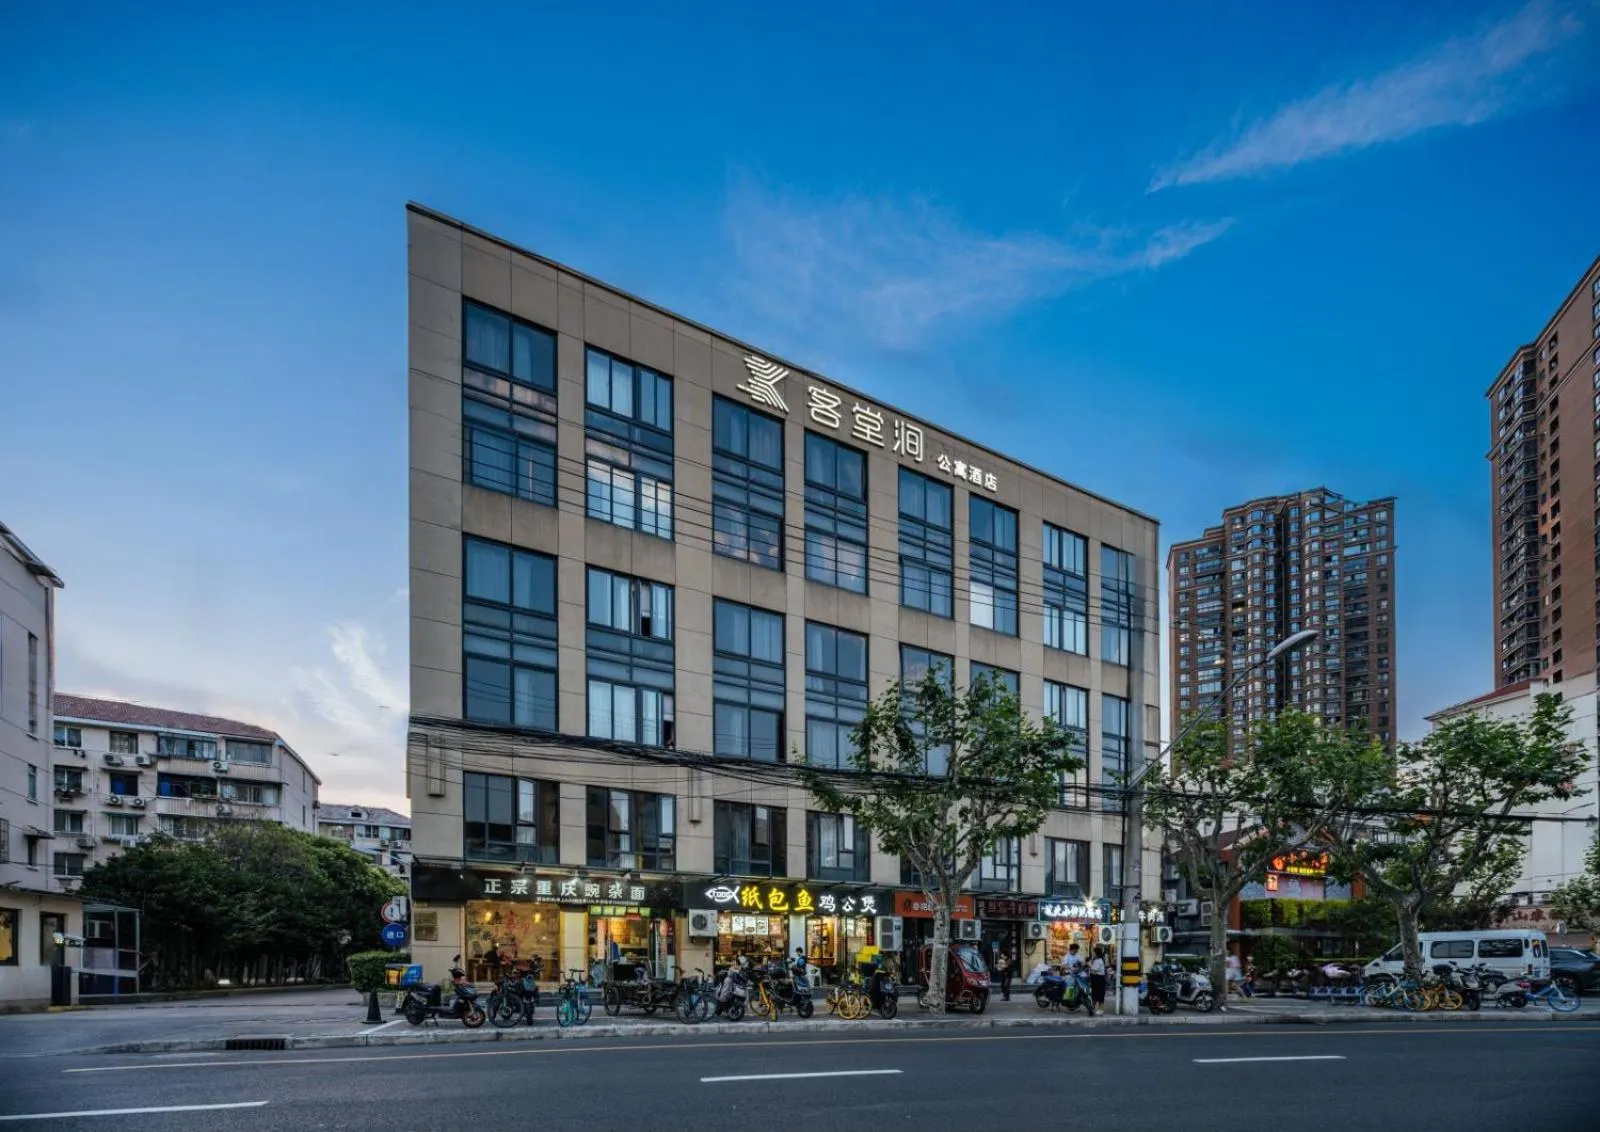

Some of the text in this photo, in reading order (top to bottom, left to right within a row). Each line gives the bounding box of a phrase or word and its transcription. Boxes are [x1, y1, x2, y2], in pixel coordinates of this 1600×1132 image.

[937, 454, 997, 491] 公寓酒店
[484, 878, 645, 900] 正宗重庆豌杂面
[741, 886, 877, 914] 纸包鱼 鸡公煲
